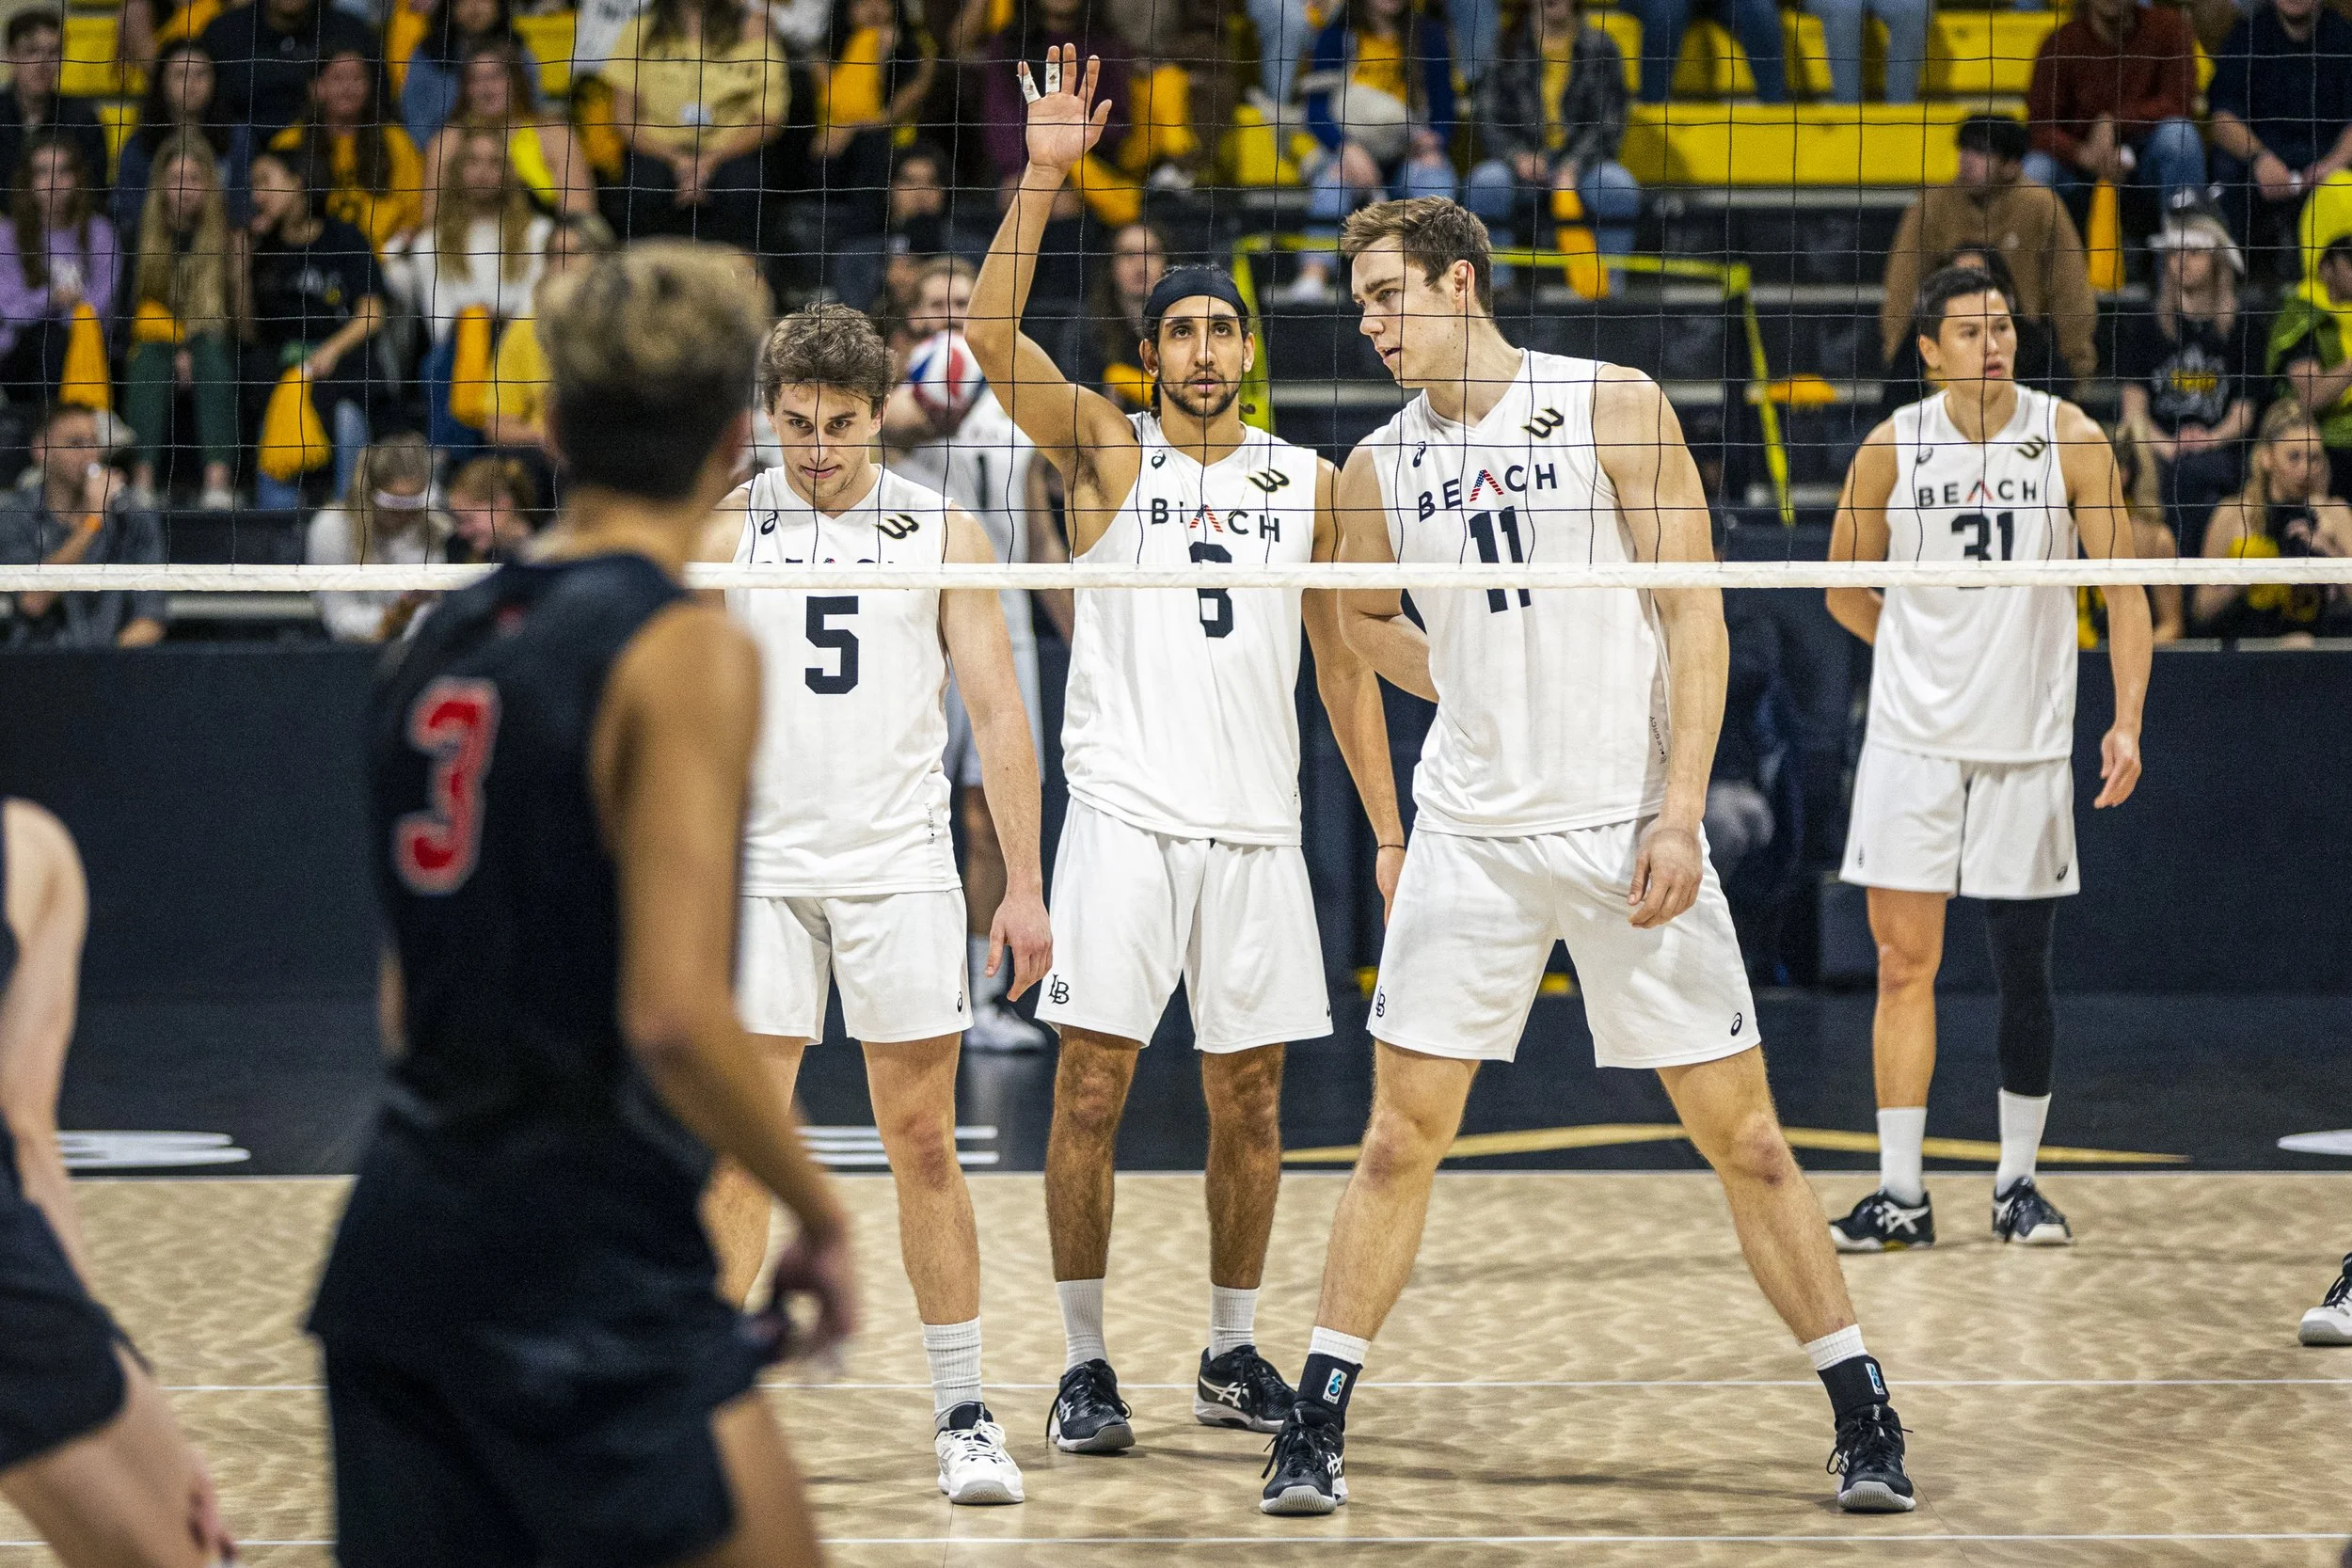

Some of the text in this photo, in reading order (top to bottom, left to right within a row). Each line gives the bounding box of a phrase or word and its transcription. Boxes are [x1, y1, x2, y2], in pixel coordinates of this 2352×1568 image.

[1418, 463, 1558, 522] BEACH
[1918, 479, 2038, 507] BEACH
[1469, 505, 1532, 613] 11
[1950, 511, 2014, 590] 31
[804, 595, 859, 694] 5
[393, 677, 501, 894] 3
